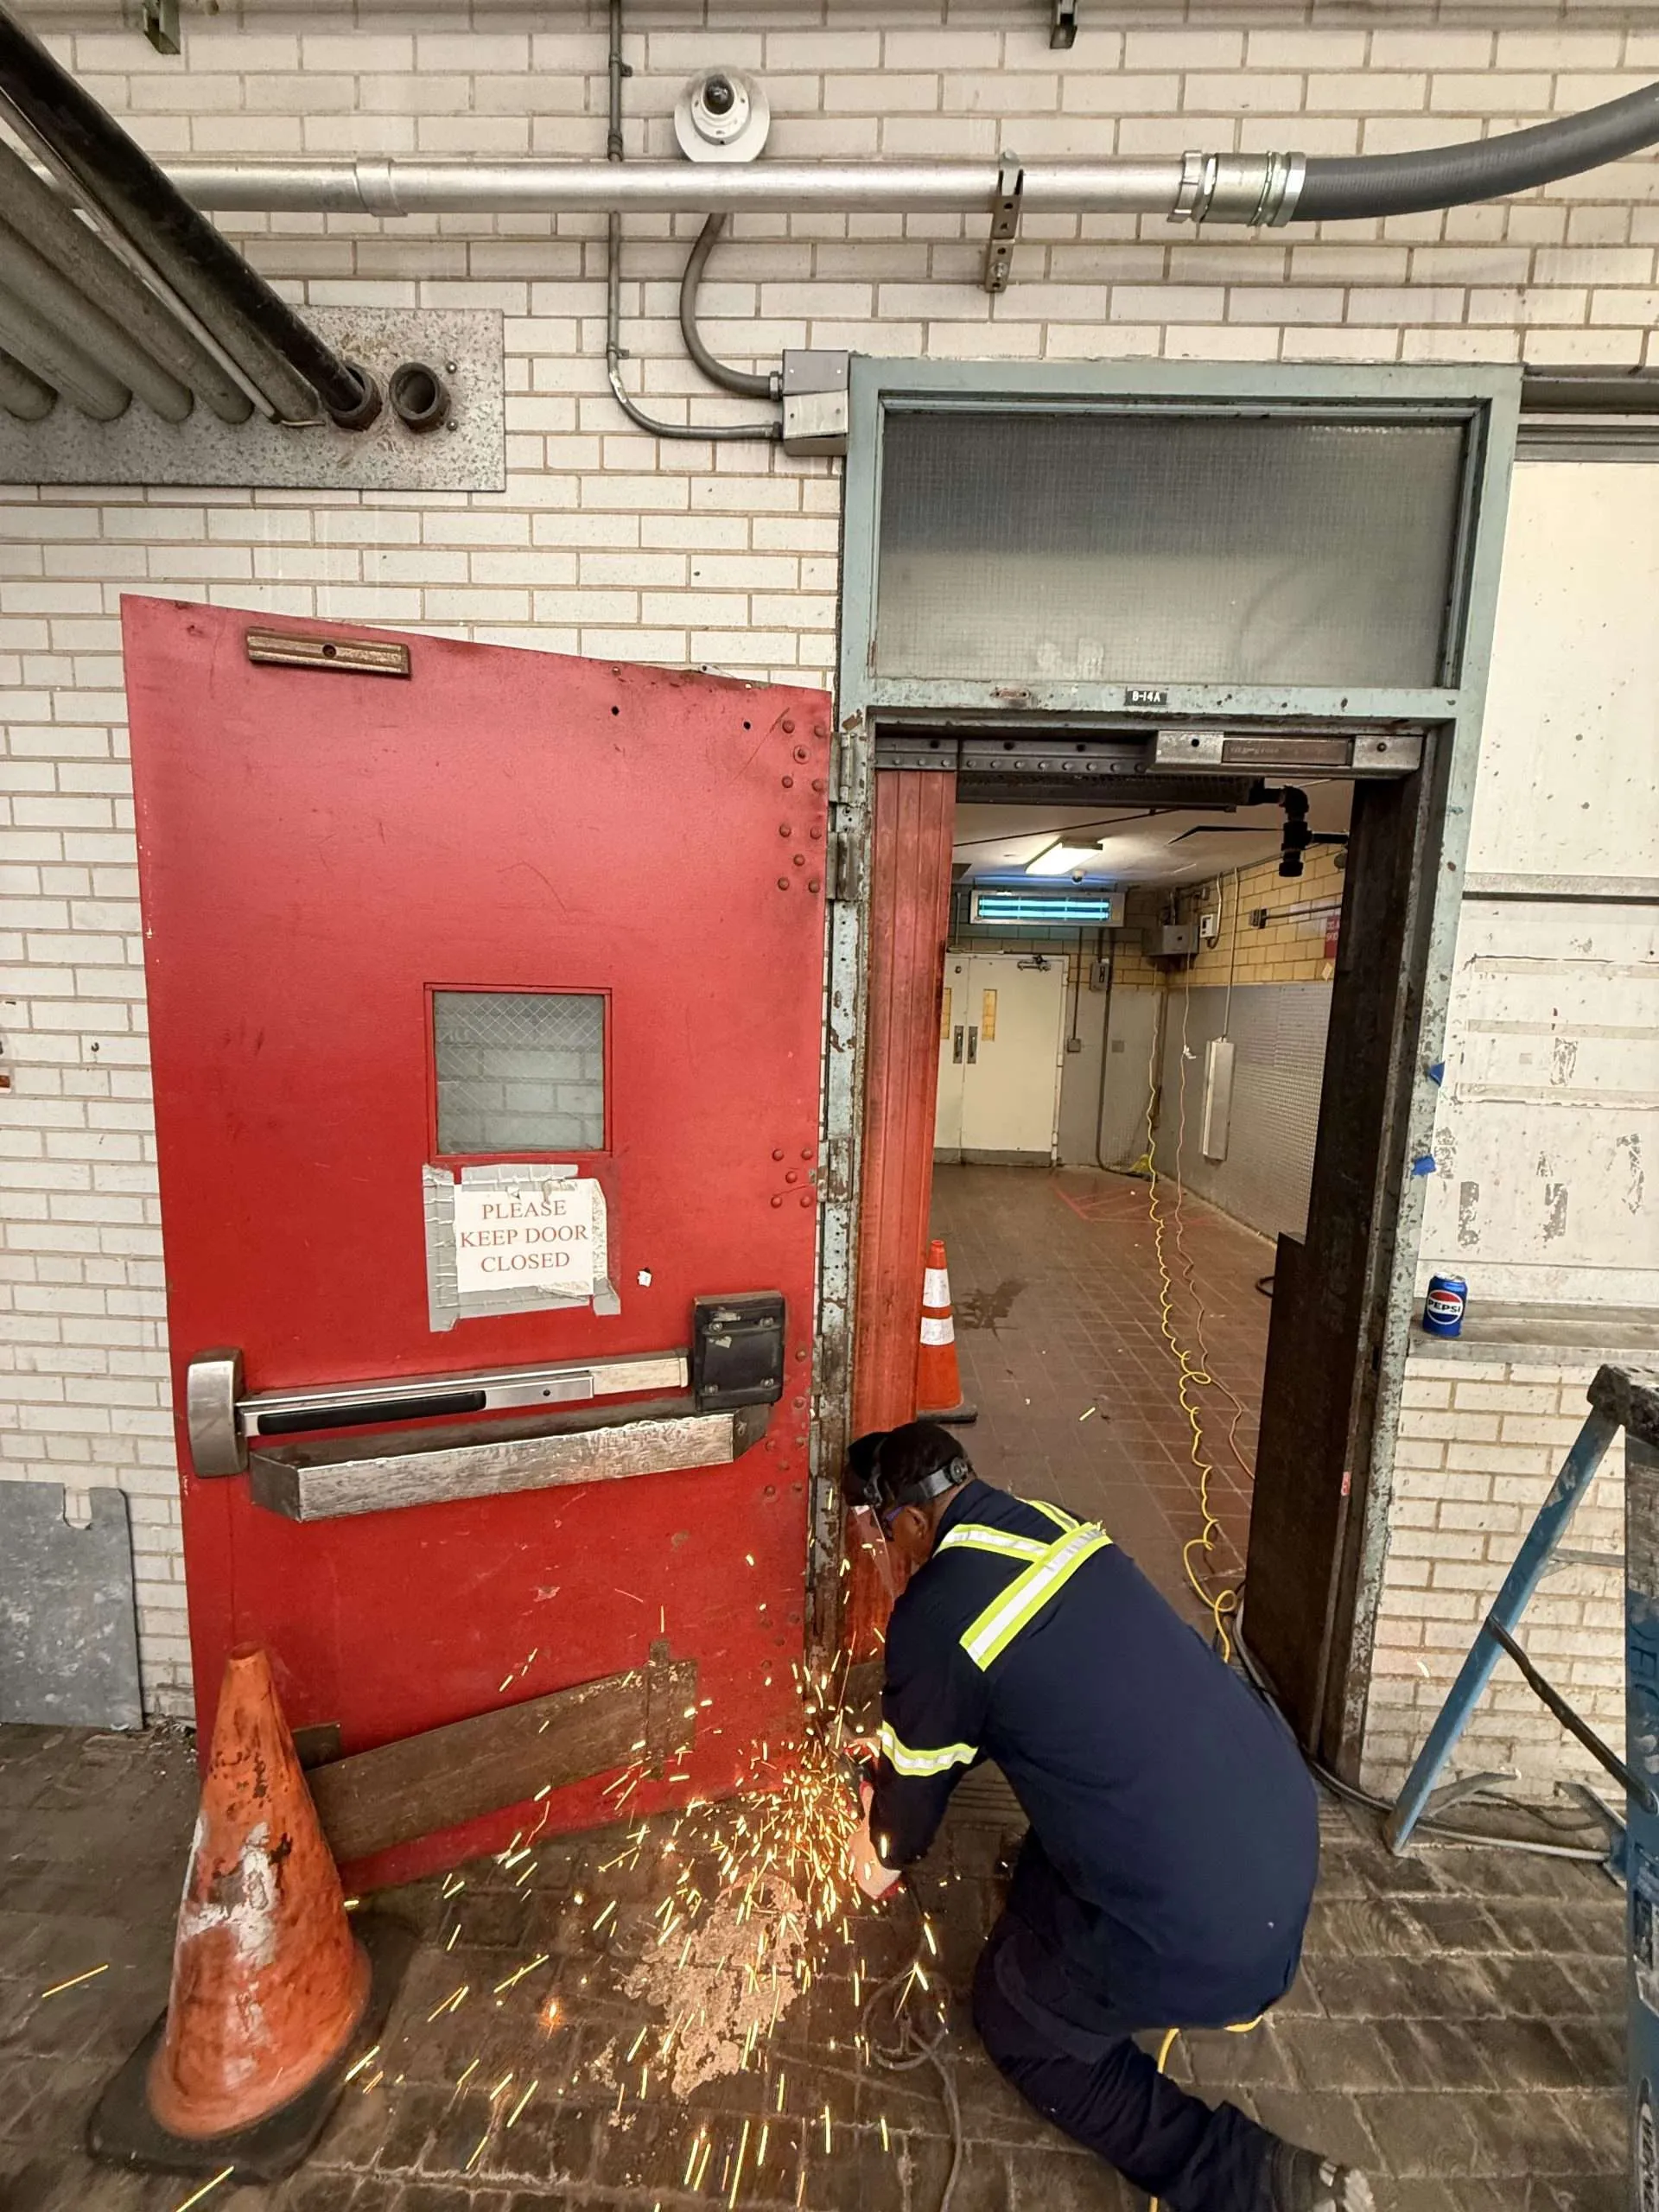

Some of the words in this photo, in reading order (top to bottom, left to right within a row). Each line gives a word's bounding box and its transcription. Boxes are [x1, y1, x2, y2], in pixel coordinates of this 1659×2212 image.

[1132, 690, 1160, 702] B-14A
[482, 1199, 568, 1220] PLEASE
[460, 1229, 518, 1249] KEEP
[525, 1224, 588, 1244] DOOR
[480, 1251, 570, 1273] CLOSED
[1427, 1299, 1461, 1313] PEPSI
